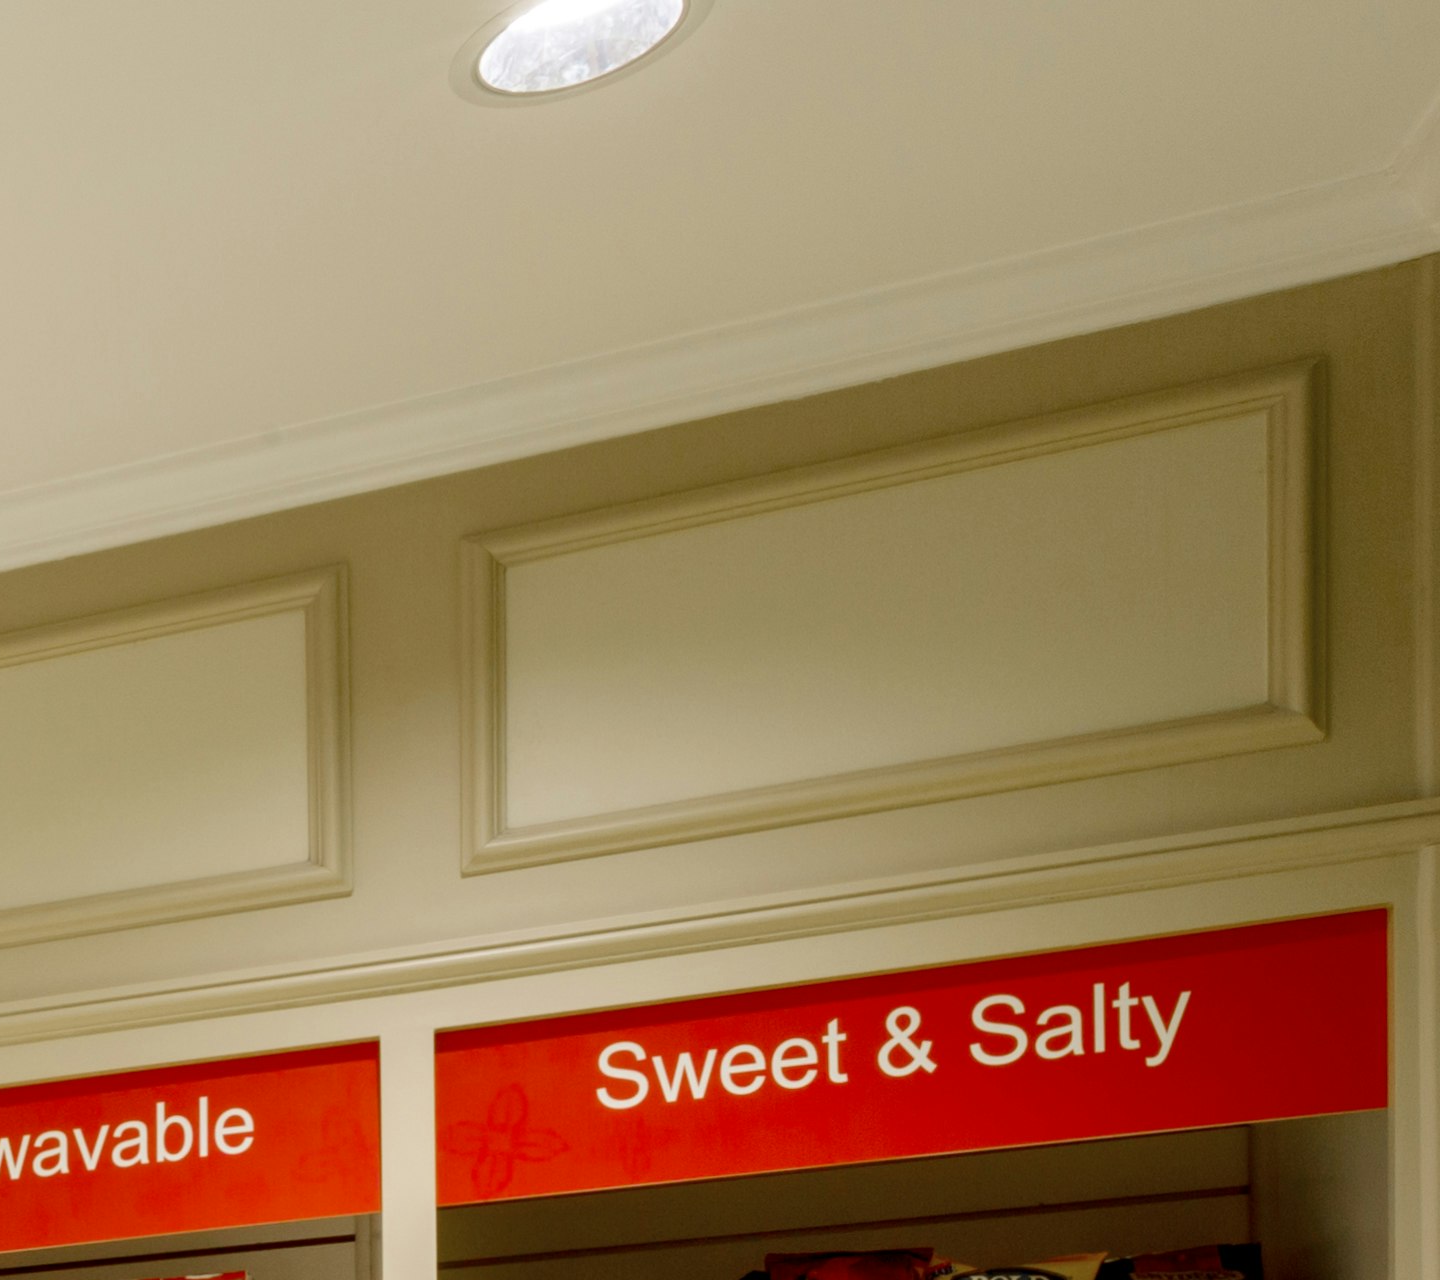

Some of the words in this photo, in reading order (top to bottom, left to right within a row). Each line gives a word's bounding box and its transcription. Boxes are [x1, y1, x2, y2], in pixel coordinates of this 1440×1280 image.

[595, 1018, 847, 1110] Sweet
[877, 1006, 938, 1078] &
[969, 982, 1190, 1067] Salty
